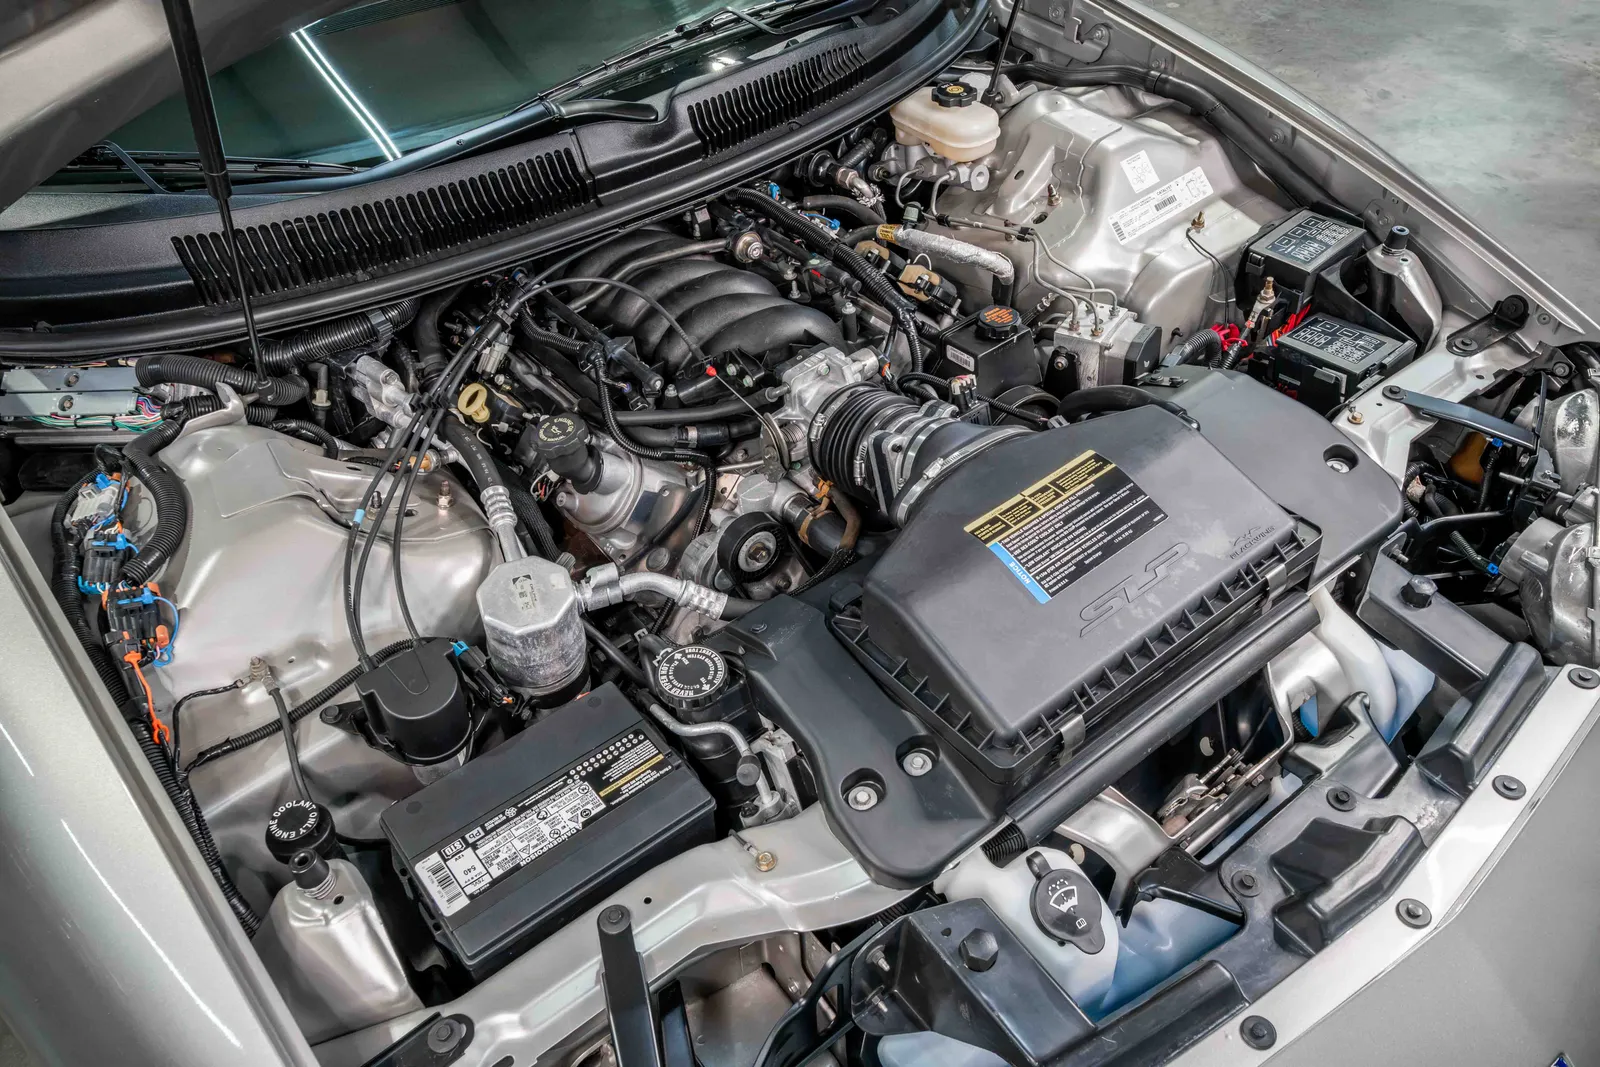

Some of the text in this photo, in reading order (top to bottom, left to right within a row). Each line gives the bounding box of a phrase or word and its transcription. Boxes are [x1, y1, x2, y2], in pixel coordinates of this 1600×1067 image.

[1157, 184, 1172, 196] CATALYST
[1009, 529, 1024, 539] VEHICLE
[1022, 519, 1040, 531] REQUIRES
[1041, 509, 1055, 518] SPECIAL
[1054, 499, 1070, 510] COOLANT
[1075, 483, 1095, 497] PROCEDURE
[1039, 527, 1056, 538] COOLANT
[1230, 525, 1276, 560] BLACKWING
[1007, 561, 1033, 585] NOTICE
[1079, 542, 1190, 638] SLP
[660, 663, 694, 696] NEVER OPEN HOT
[269, 800, 317, 839] ENGINE COOLANT ONLY
[468, 829, 481, 840] Pb
[519, 827, 578, 867] DANGER/POISON
[462, 864, 477, 876] 540
